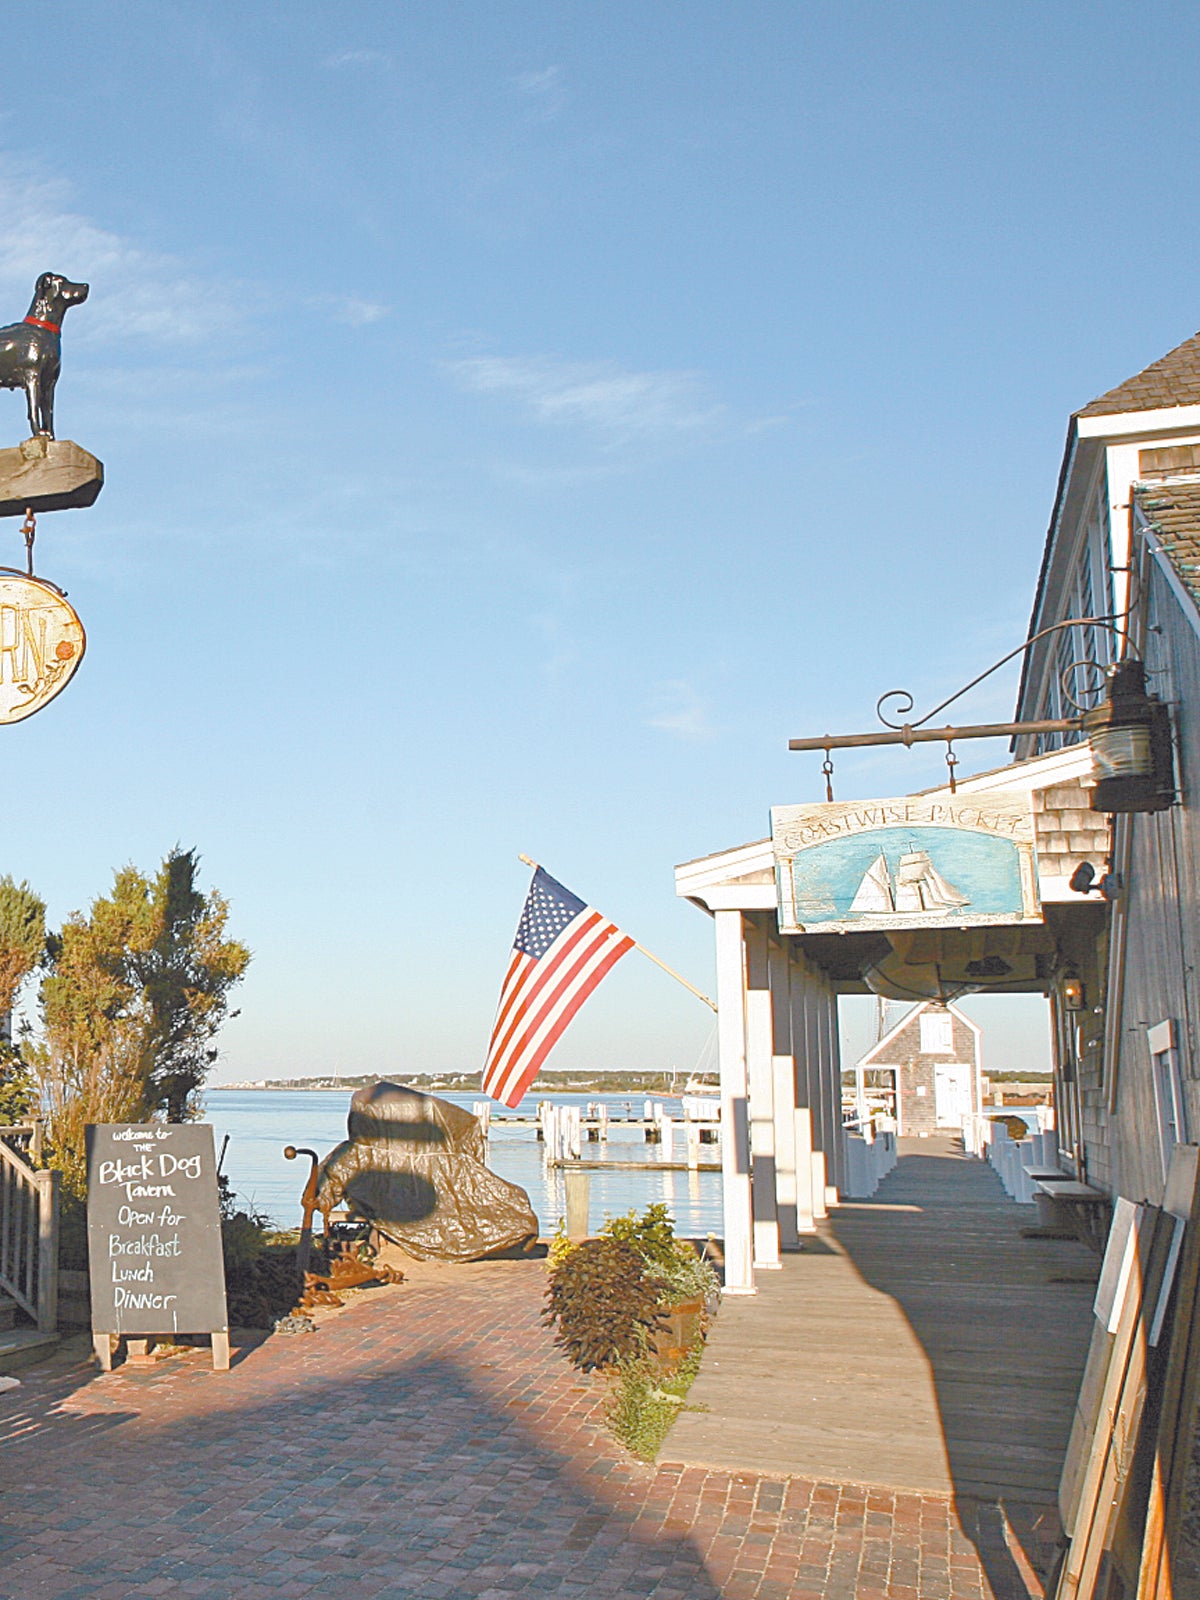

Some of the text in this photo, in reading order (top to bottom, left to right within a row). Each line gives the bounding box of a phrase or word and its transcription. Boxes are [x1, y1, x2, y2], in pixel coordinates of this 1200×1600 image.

[155, 1127, 173, 1140] to
[133, 1143, 157, 1152] THE
[99, 1153, 201, 1184] Black Dog
[118, 1181, 176, 1202] Tavern
[158, 1205, 187, 1227] for
[109, 1233, 182, 1258] Breakfast
